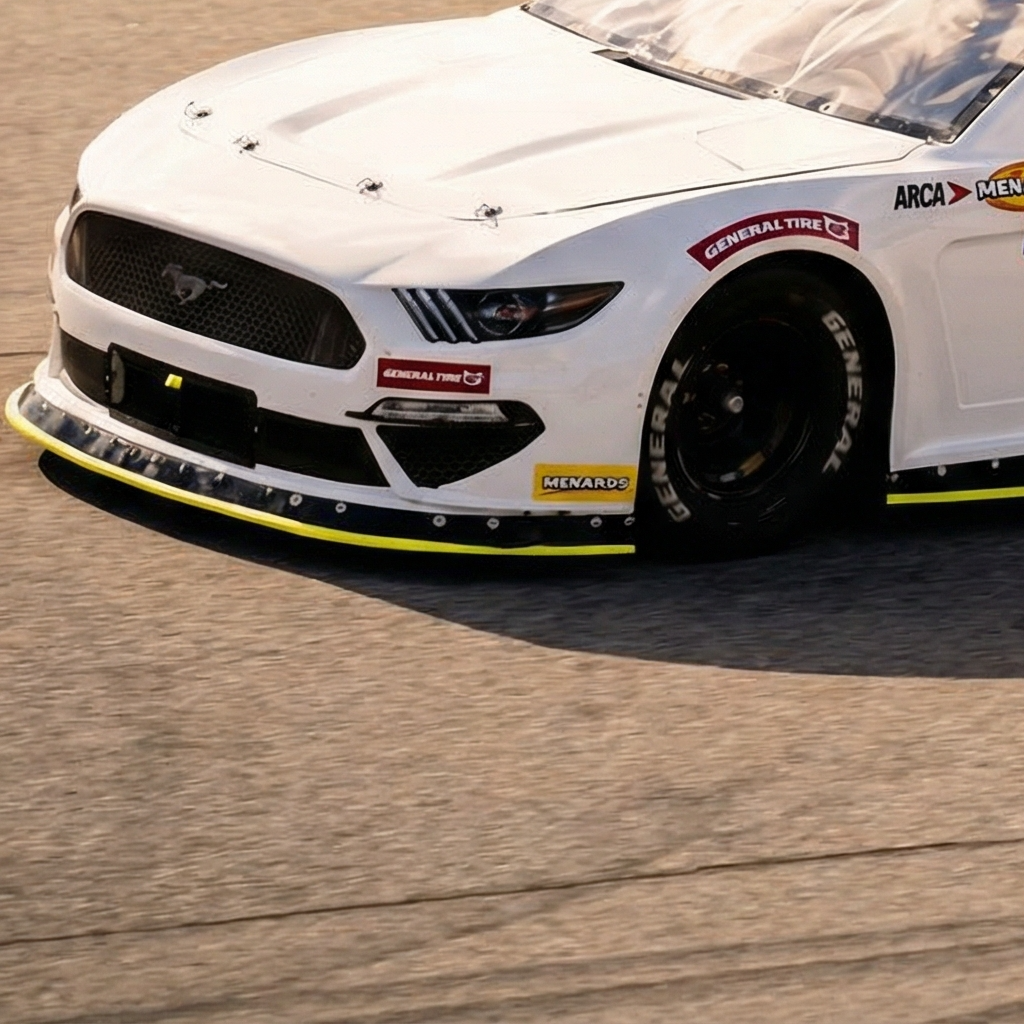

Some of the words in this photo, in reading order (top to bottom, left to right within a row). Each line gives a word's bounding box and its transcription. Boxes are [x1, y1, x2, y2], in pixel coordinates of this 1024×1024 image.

[894, 181, 946, 210] ARCA
[704, 219, 784, 260] GENERAL
[785, 217, 823, 232] TIRE
[820, 309, 863, 474] GENERAL
[649, 353, 695, 523] GENERAL
[542, 475, 630, 491] MENARDS
